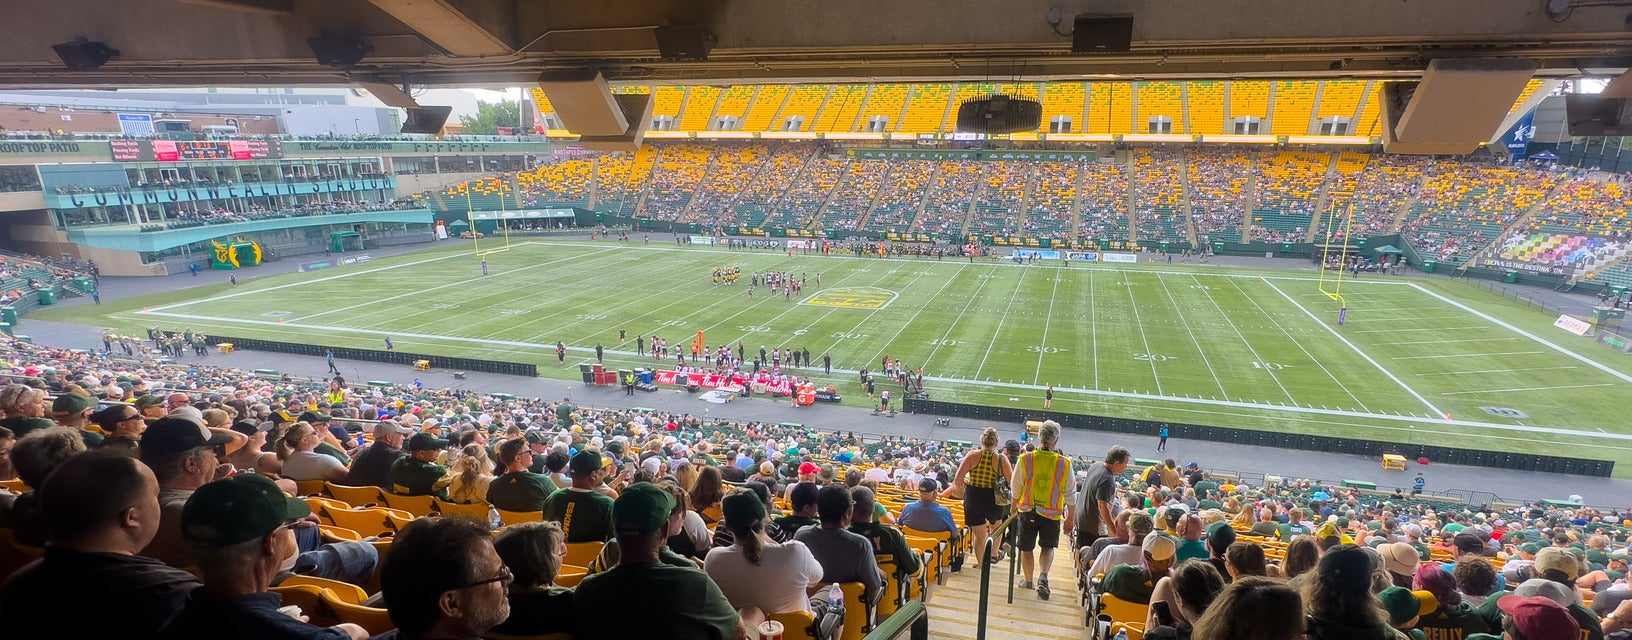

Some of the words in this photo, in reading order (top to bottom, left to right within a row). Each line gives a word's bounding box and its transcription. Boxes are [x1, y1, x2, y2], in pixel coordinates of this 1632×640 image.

[0, 142, 47, 153] ROOFTOP
[49, 142, 80, 153] PATIO
[71, 181, 297, 208] COMMONWEALTH
[312, 177, 392, 193] STADIUM
[1512, 262, 1524, 270] THE
[1133, 353, 1167, 362] 20
[798, 394, 806, 403] G
